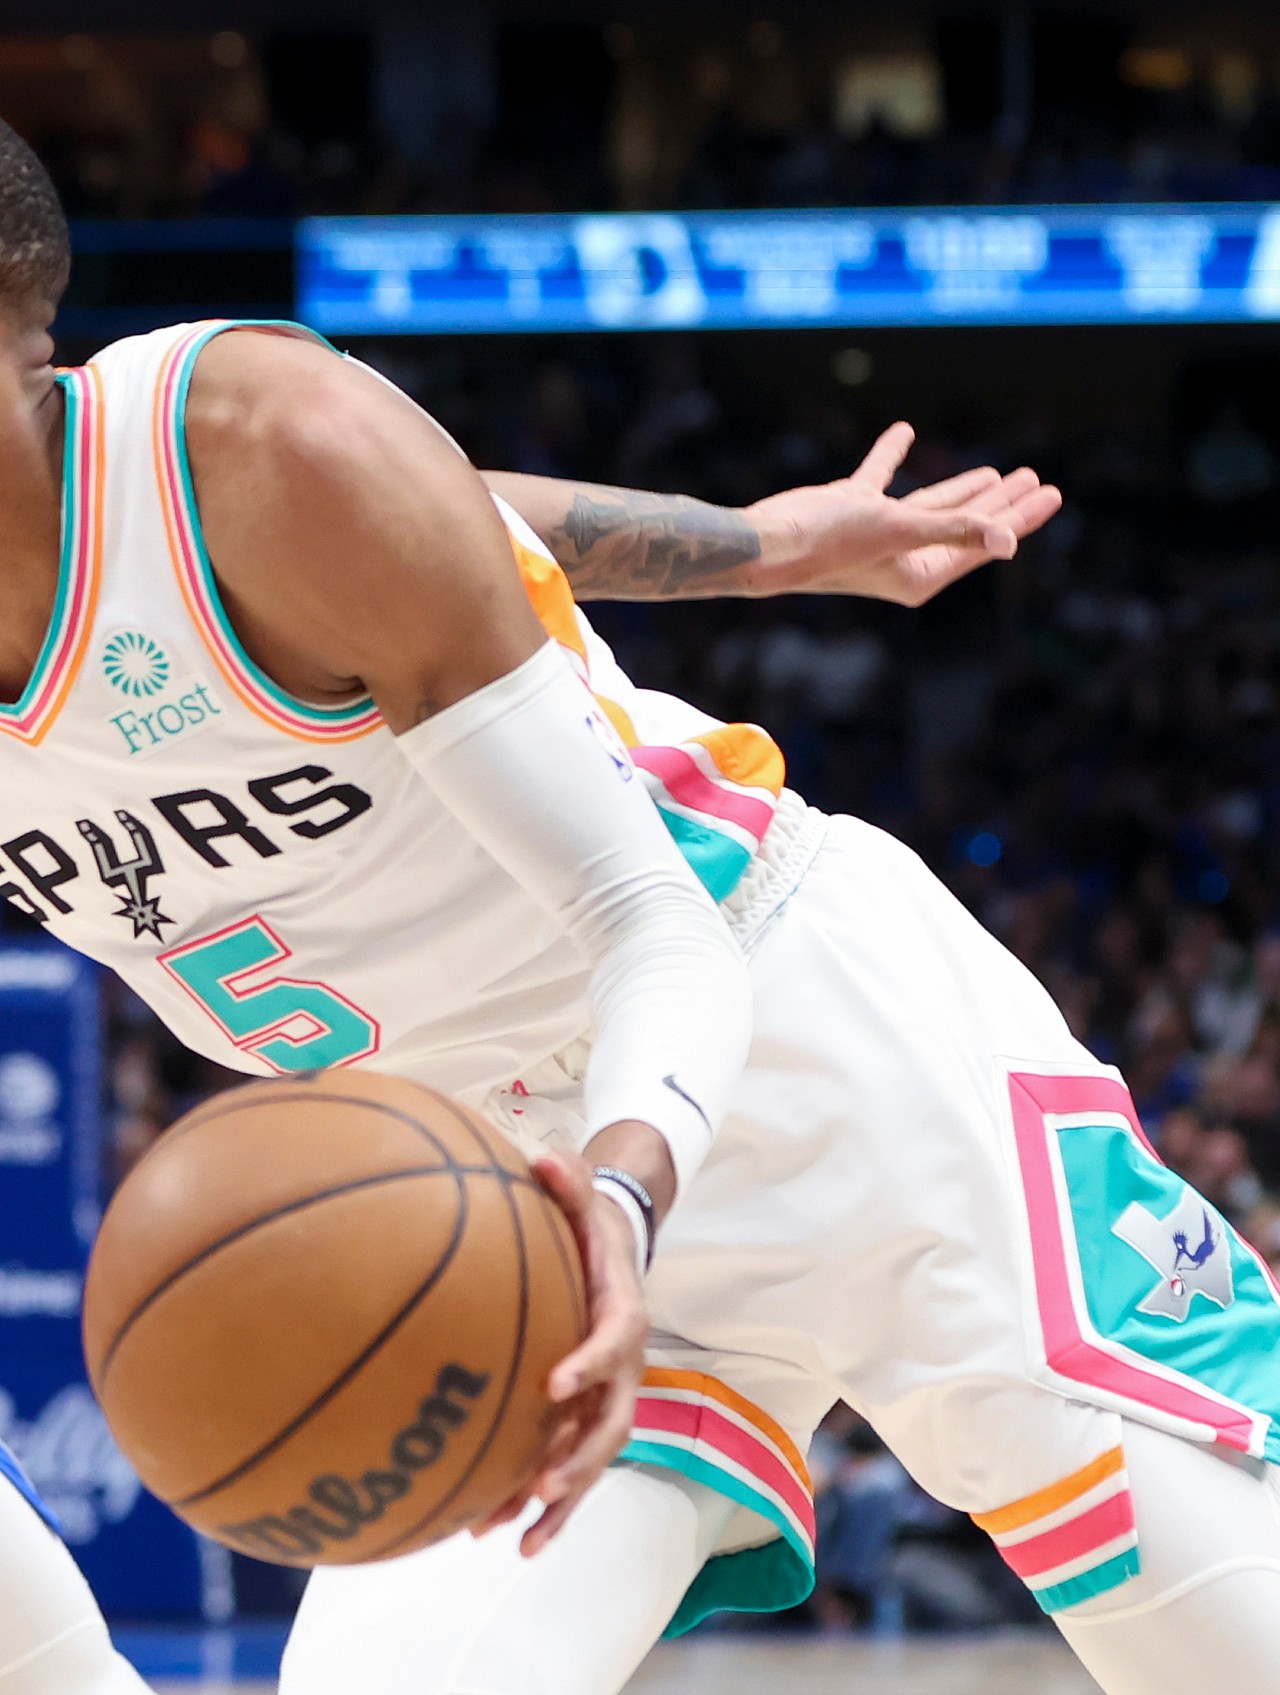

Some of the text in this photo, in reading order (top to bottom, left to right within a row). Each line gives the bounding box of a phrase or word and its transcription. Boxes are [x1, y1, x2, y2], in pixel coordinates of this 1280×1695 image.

[109, 681, 222, 755] Frost
[156, 913, 382, 1075] 5
[218, 1361, 492, 1557] Wilson
